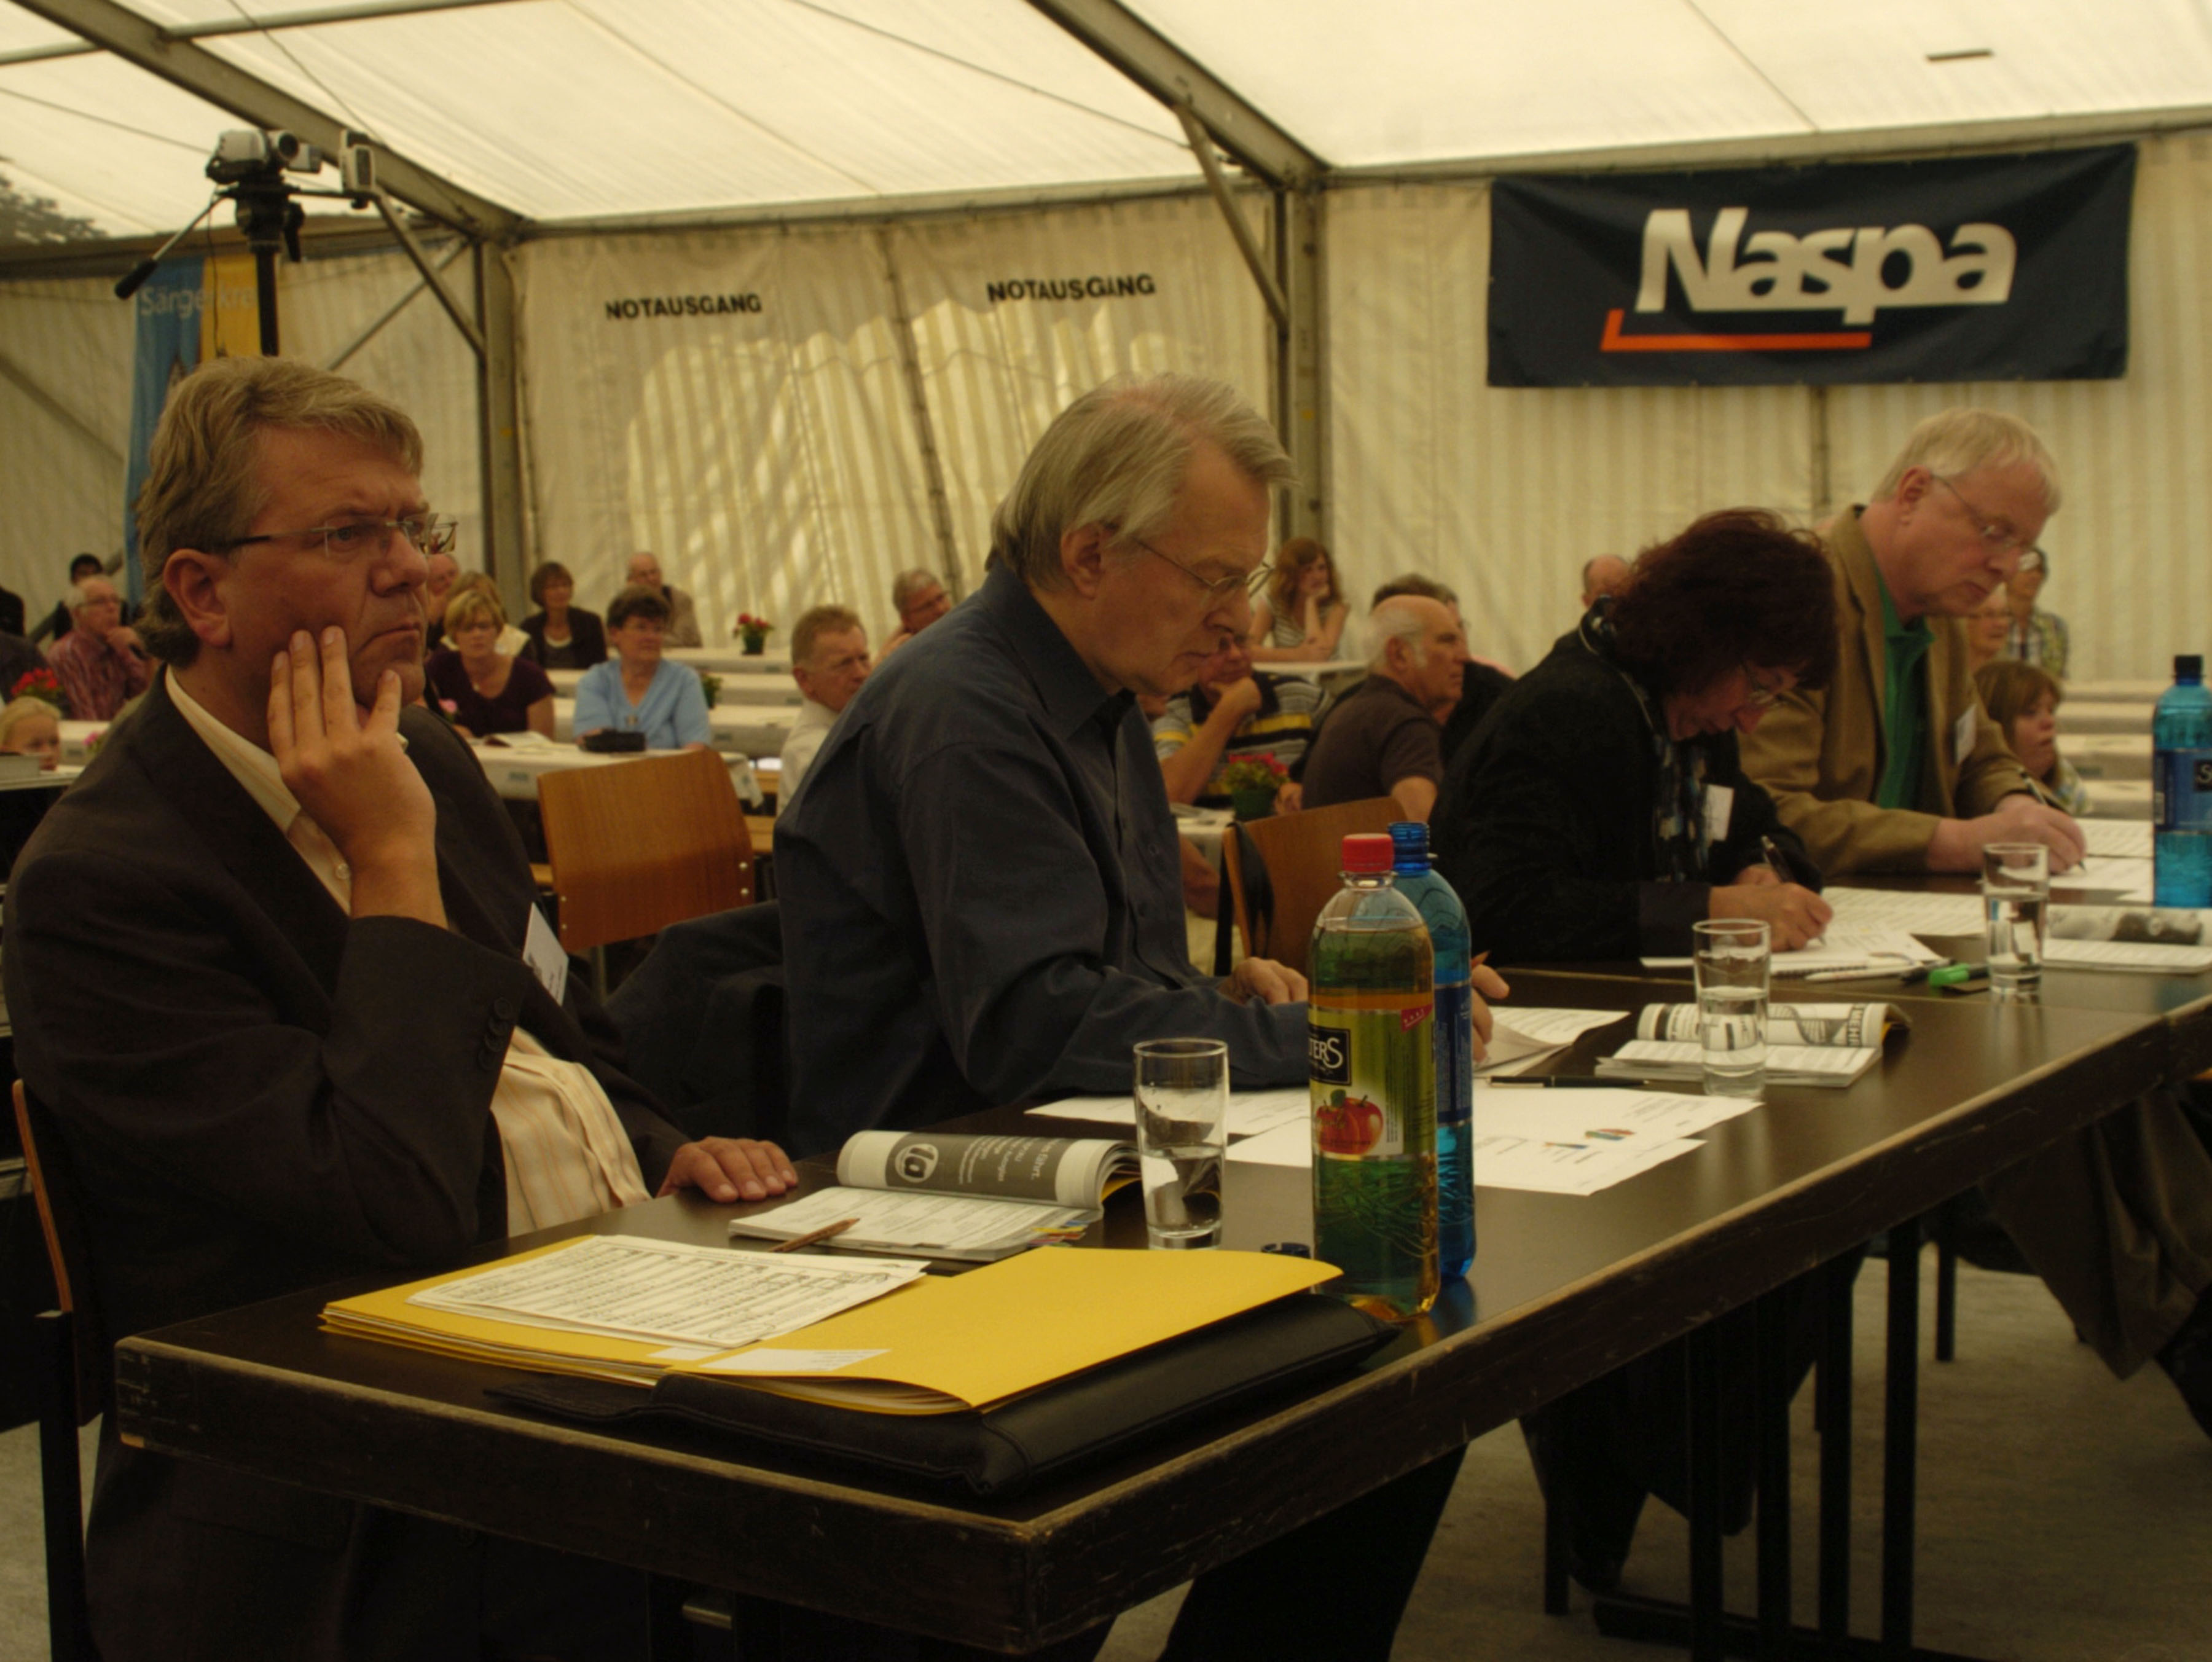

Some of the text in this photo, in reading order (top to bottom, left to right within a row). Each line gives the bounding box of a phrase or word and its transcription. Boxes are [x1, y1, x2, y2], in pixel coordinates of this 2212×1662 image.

[1634, 207, 2018, 326] Naspa
[987, 274, 1155, 302] NOTAUSGANG
[605, 293, 762, 320] NOTAUSGANG
[1308, 1037, 1344, 1069] TERS
